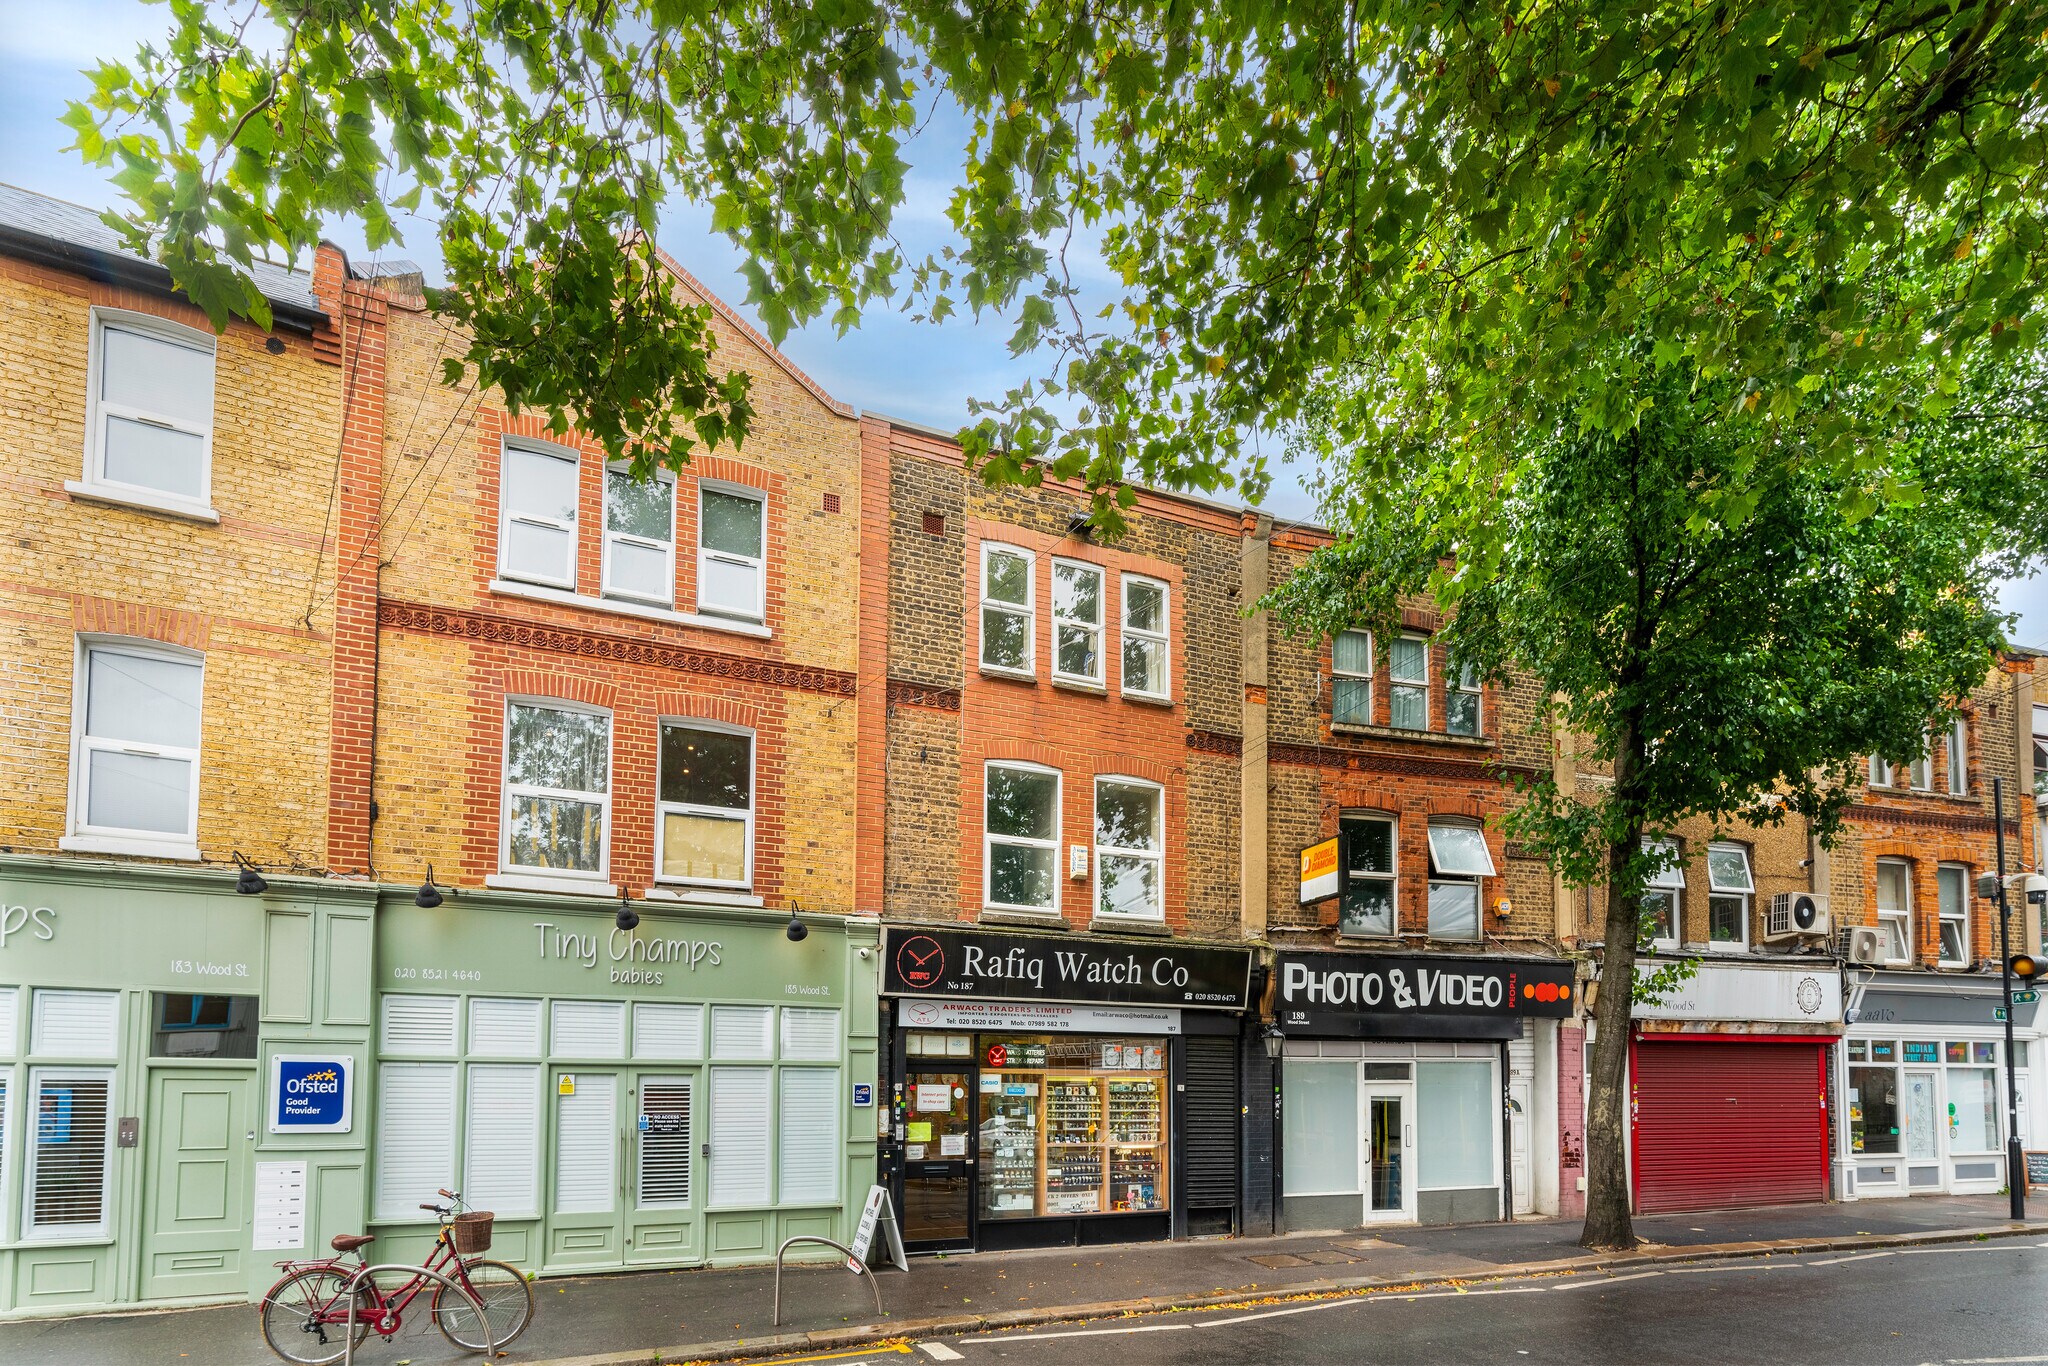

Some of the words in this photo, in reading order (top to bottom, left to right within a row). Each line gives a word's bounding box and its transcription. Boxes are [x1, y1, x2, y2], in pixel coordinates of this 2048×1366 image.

[1314, 846, 1334, 862] DOUBLE
[1312, 856, 1336, 872] DIAMOND
[534, 923, 598, 968] Tiny
[608, 927, 722, 971] Champs
[171, 960, 192, 974] 183
[197, 962, 232, 976] Wood
[961, 945, 1044, 989] Rafiq
[1055, 952, 1142, 985] Watch
[1152, 957, 1189, 987] Co
[394, 968, 416, 978] 020
[422, 968, 448, 980] 8521
[452, 970, 481, 981] 4640
[610, 966, 664, 985] babies
[784, 984, 798, 994] 185
[800, 985, 820, 995] Wood
[948, 981, 958, 990] No
[960, 982, 974, 990] 187
[1508, 972, 1517, 1008] PEOPLE
[943, 1004, 984, 1012] ARWACO
[1666, 1000, 1686, 1010] Wood
[1688, 1001, 1695, 1010] St
[1292, 1012, 1305, 1020] 189
[1906, 1044, 1934, 1053] INDIAN
[1904, 1054, 1922, 1062] STREET
[1924, 1054, 1936, 1062] FOOD
[286, 1078, 338, 1093] Ofsted
